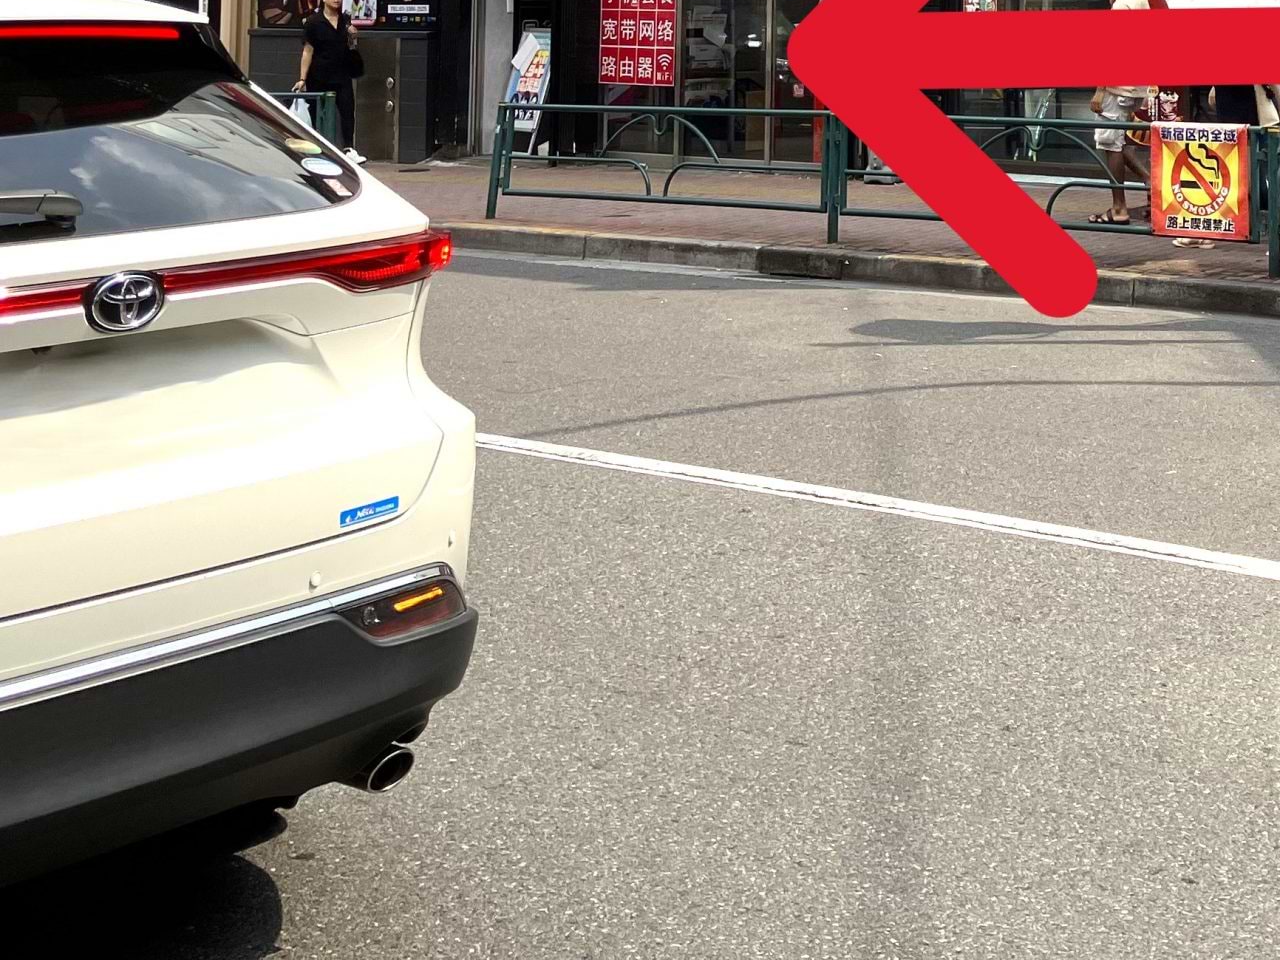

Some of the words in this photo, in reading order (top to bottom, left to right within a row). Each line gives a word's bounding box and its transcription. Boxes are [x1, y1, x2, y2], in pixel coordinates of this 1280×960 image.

[602, 19, 674, 42] 宽带网络
[601, 55, 653, 78] 路由器
[1160, 126, 1237, 143] 新宿区内全域
[1172, 183, 1184, 204] NO
[1183, 185, 1229, 217] SMOKING
[1166, 216, 1236, 233] 路上喫煙禁止
